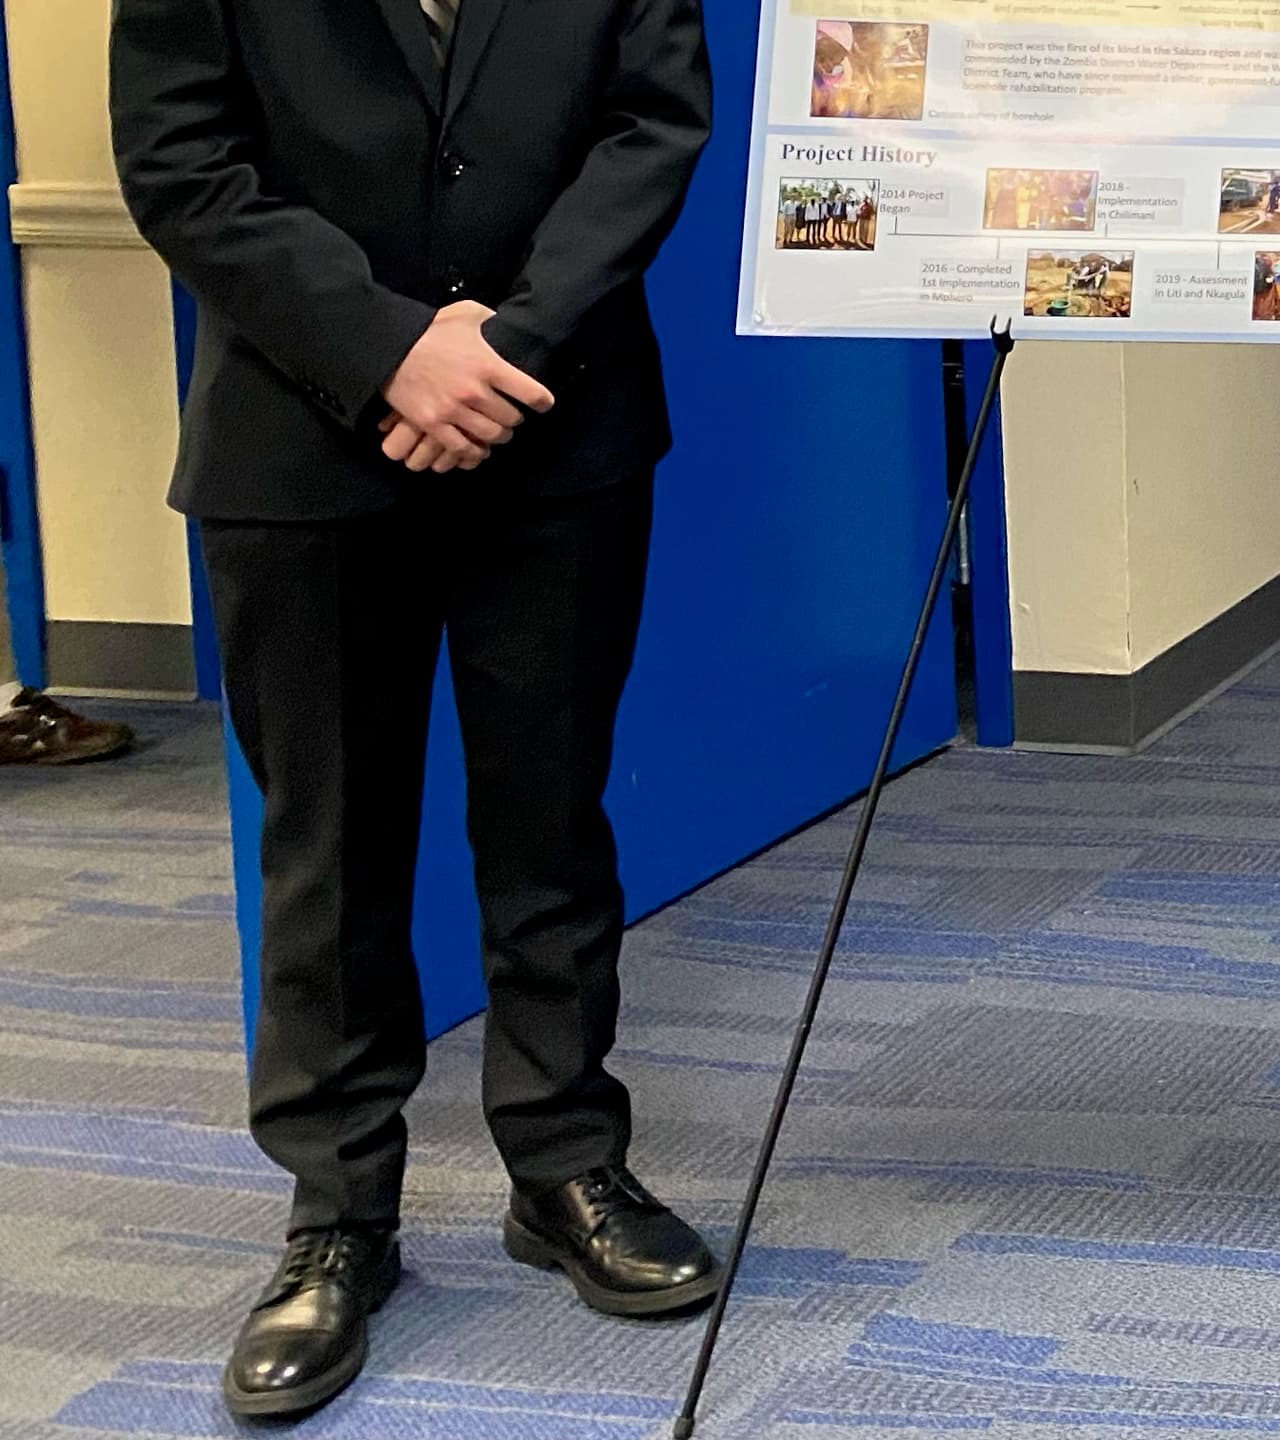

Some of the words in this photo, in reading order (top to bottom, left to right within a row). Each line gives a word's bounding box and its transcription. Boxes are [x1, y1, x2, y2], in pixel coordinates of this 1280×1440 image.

[780, 143, 852, 164] Project
[861, 144, 938, 168] History
[878, 188, 905, 199] 2014
[908, 190, 944, 201] Project
[877, 203, 910, 215] Began
